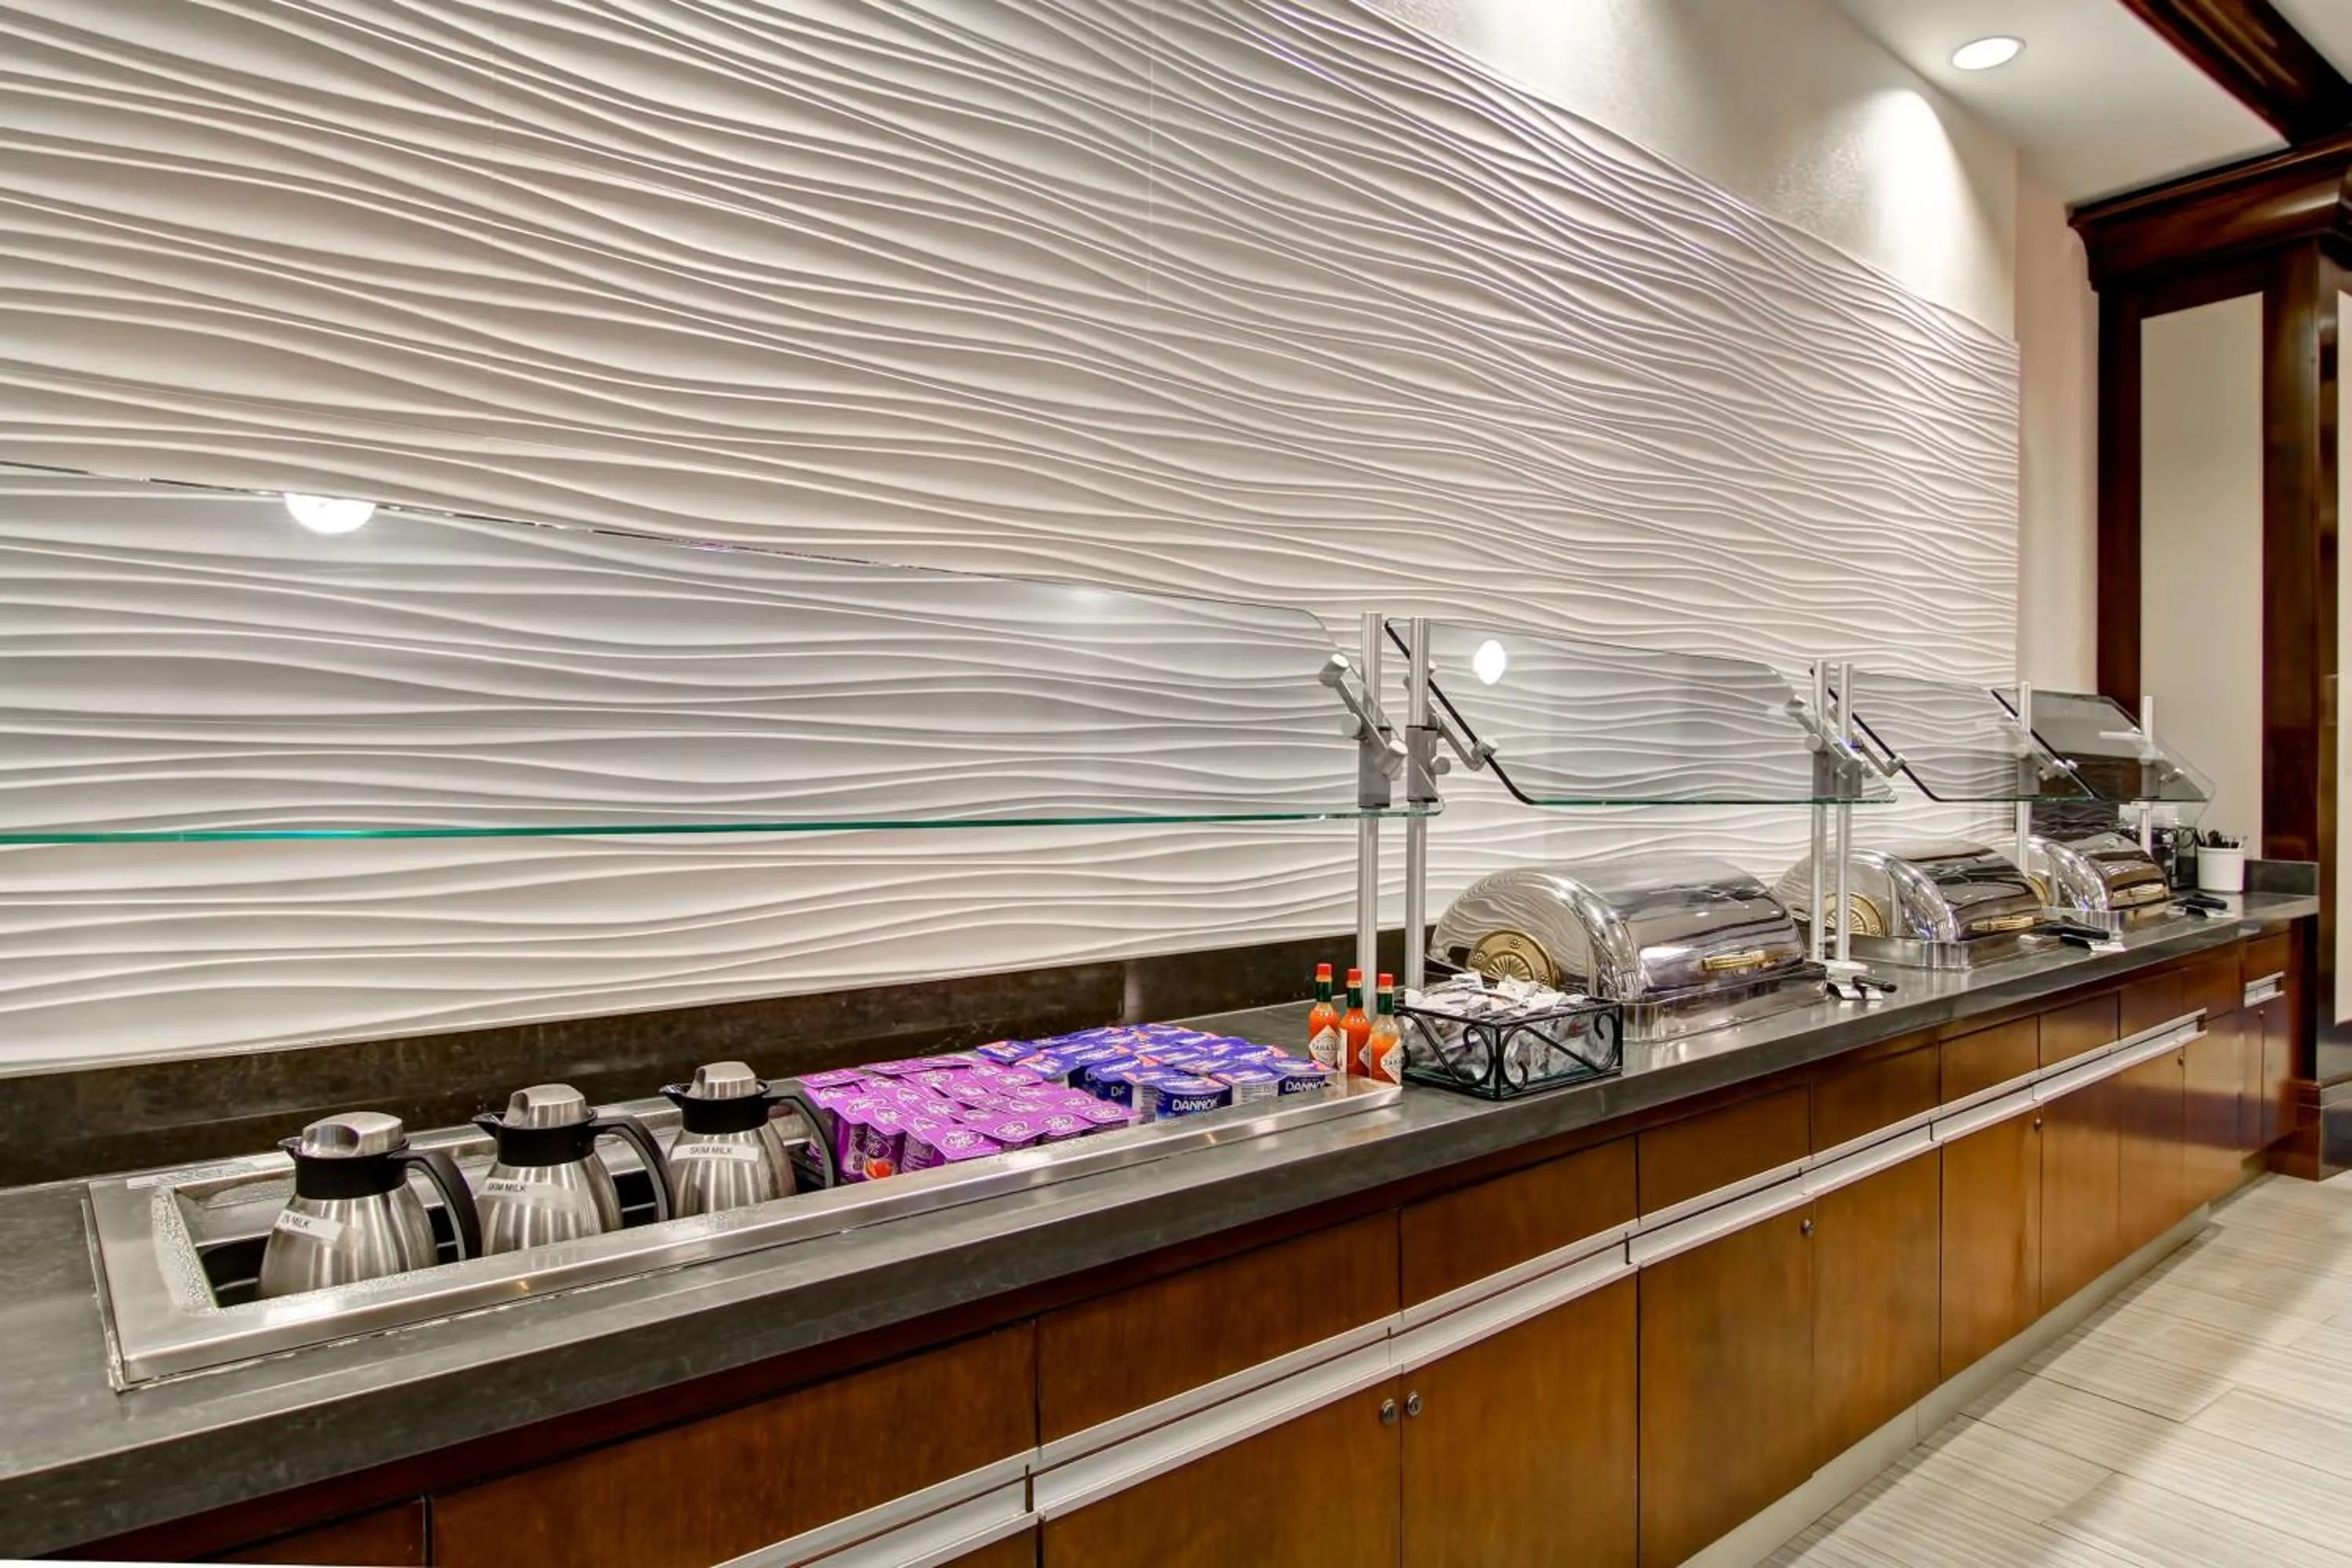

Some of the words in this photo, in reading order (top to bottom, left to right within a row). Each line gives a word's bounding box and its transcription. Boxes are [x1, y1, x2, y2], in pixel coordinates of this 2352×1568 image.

[710, 1146, 733, 1155] MILK
[505, 1182, 527, 1192] MILK
[291, 1215, 312, 1230] MILK
